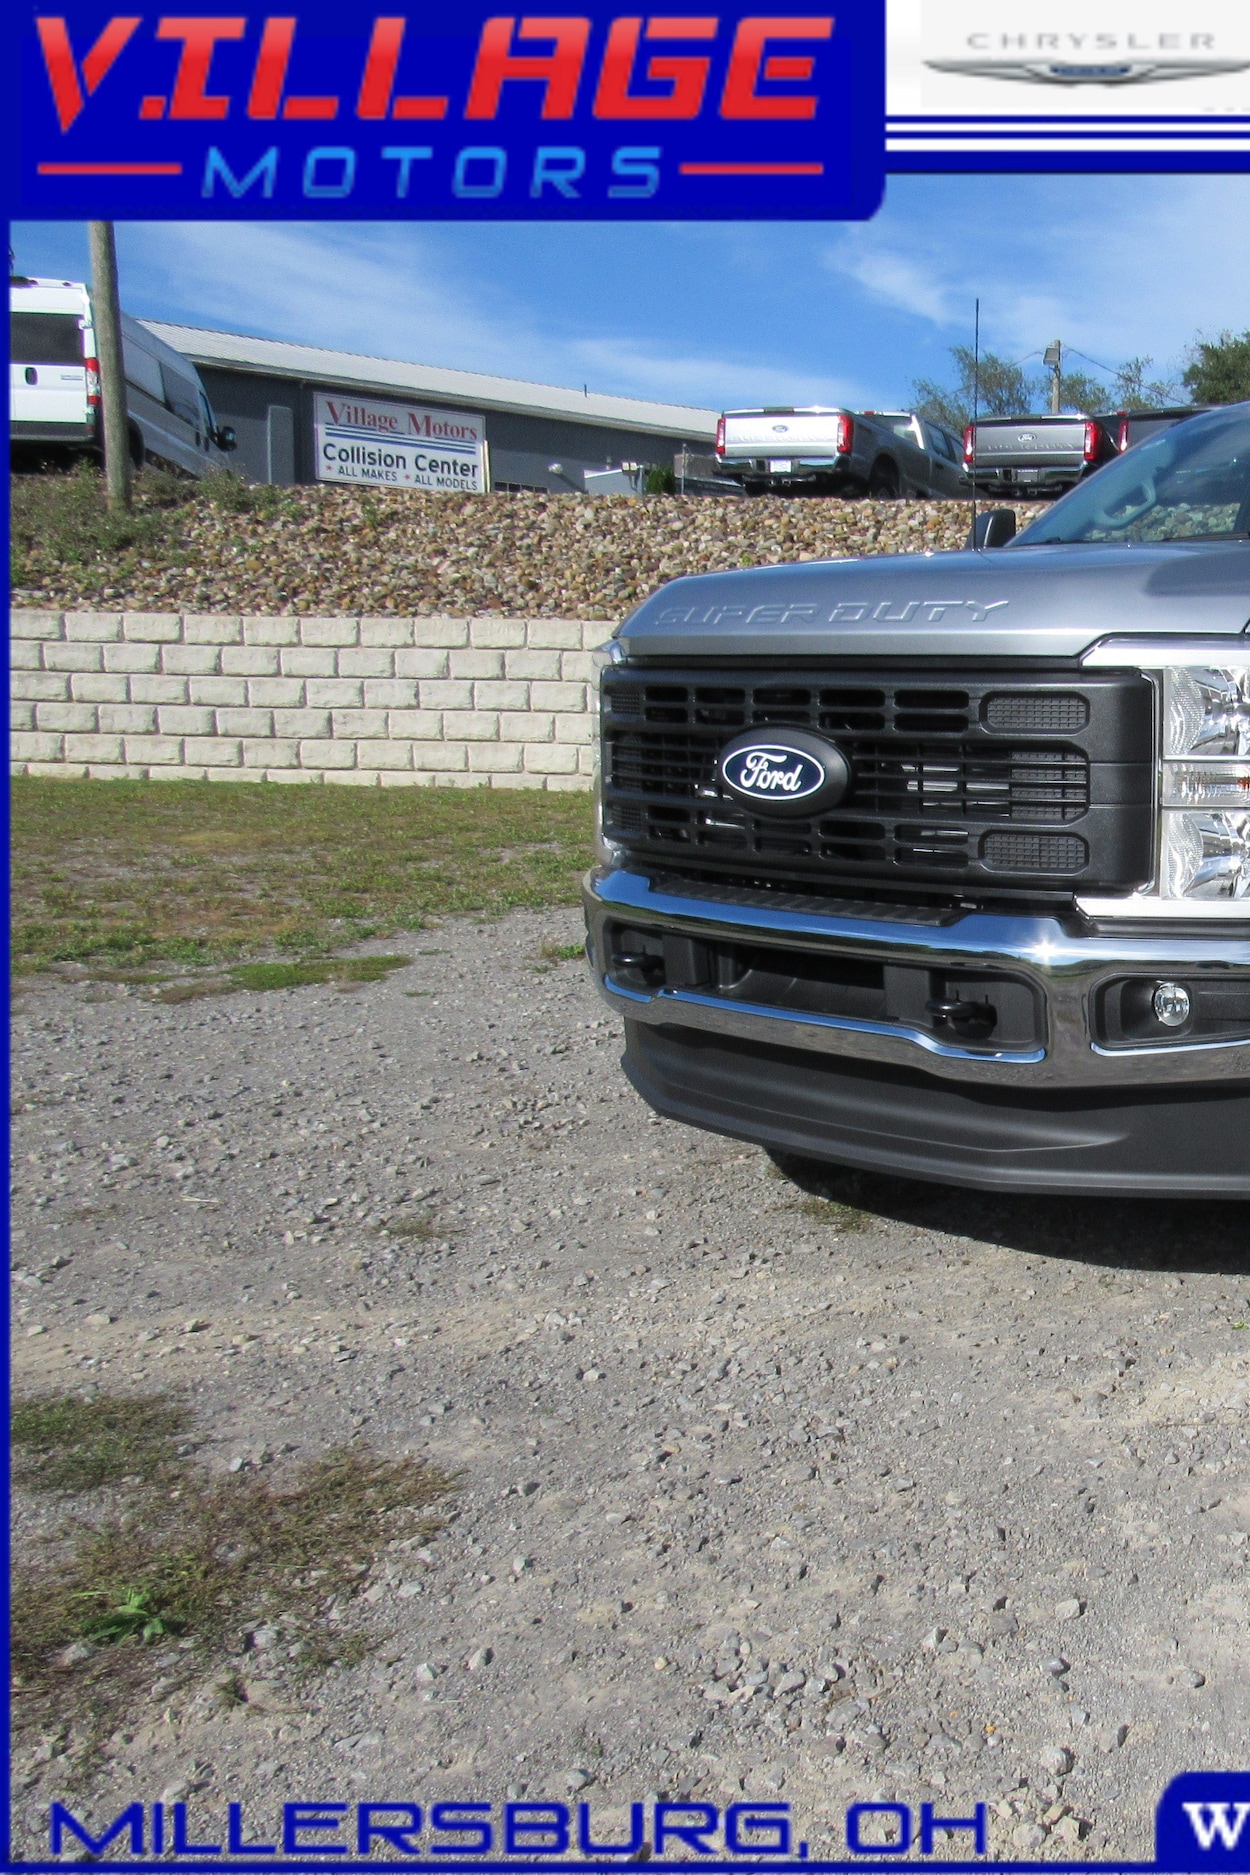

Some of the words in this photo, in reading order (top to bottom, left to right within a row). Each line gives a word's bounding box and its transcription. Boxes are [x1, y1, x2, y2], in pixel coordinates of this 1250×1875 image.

[325, 401, 398, 433] Village
[408, 412, 477, 440] Motors
[323, 443, 406, 469] Collision
[415, 454, 478, 478] Center
[338, 465, 357, 477] ALL
[362, 467, 397, 482] MAKES
[414, 474, 432, 486] ALL
[436, 477, 478, 491] MODELS
[655, 603, 821, 625] SUPER
[828, 600, 1009, 623] DUTY
[740, 751, 803, 792] Ford
